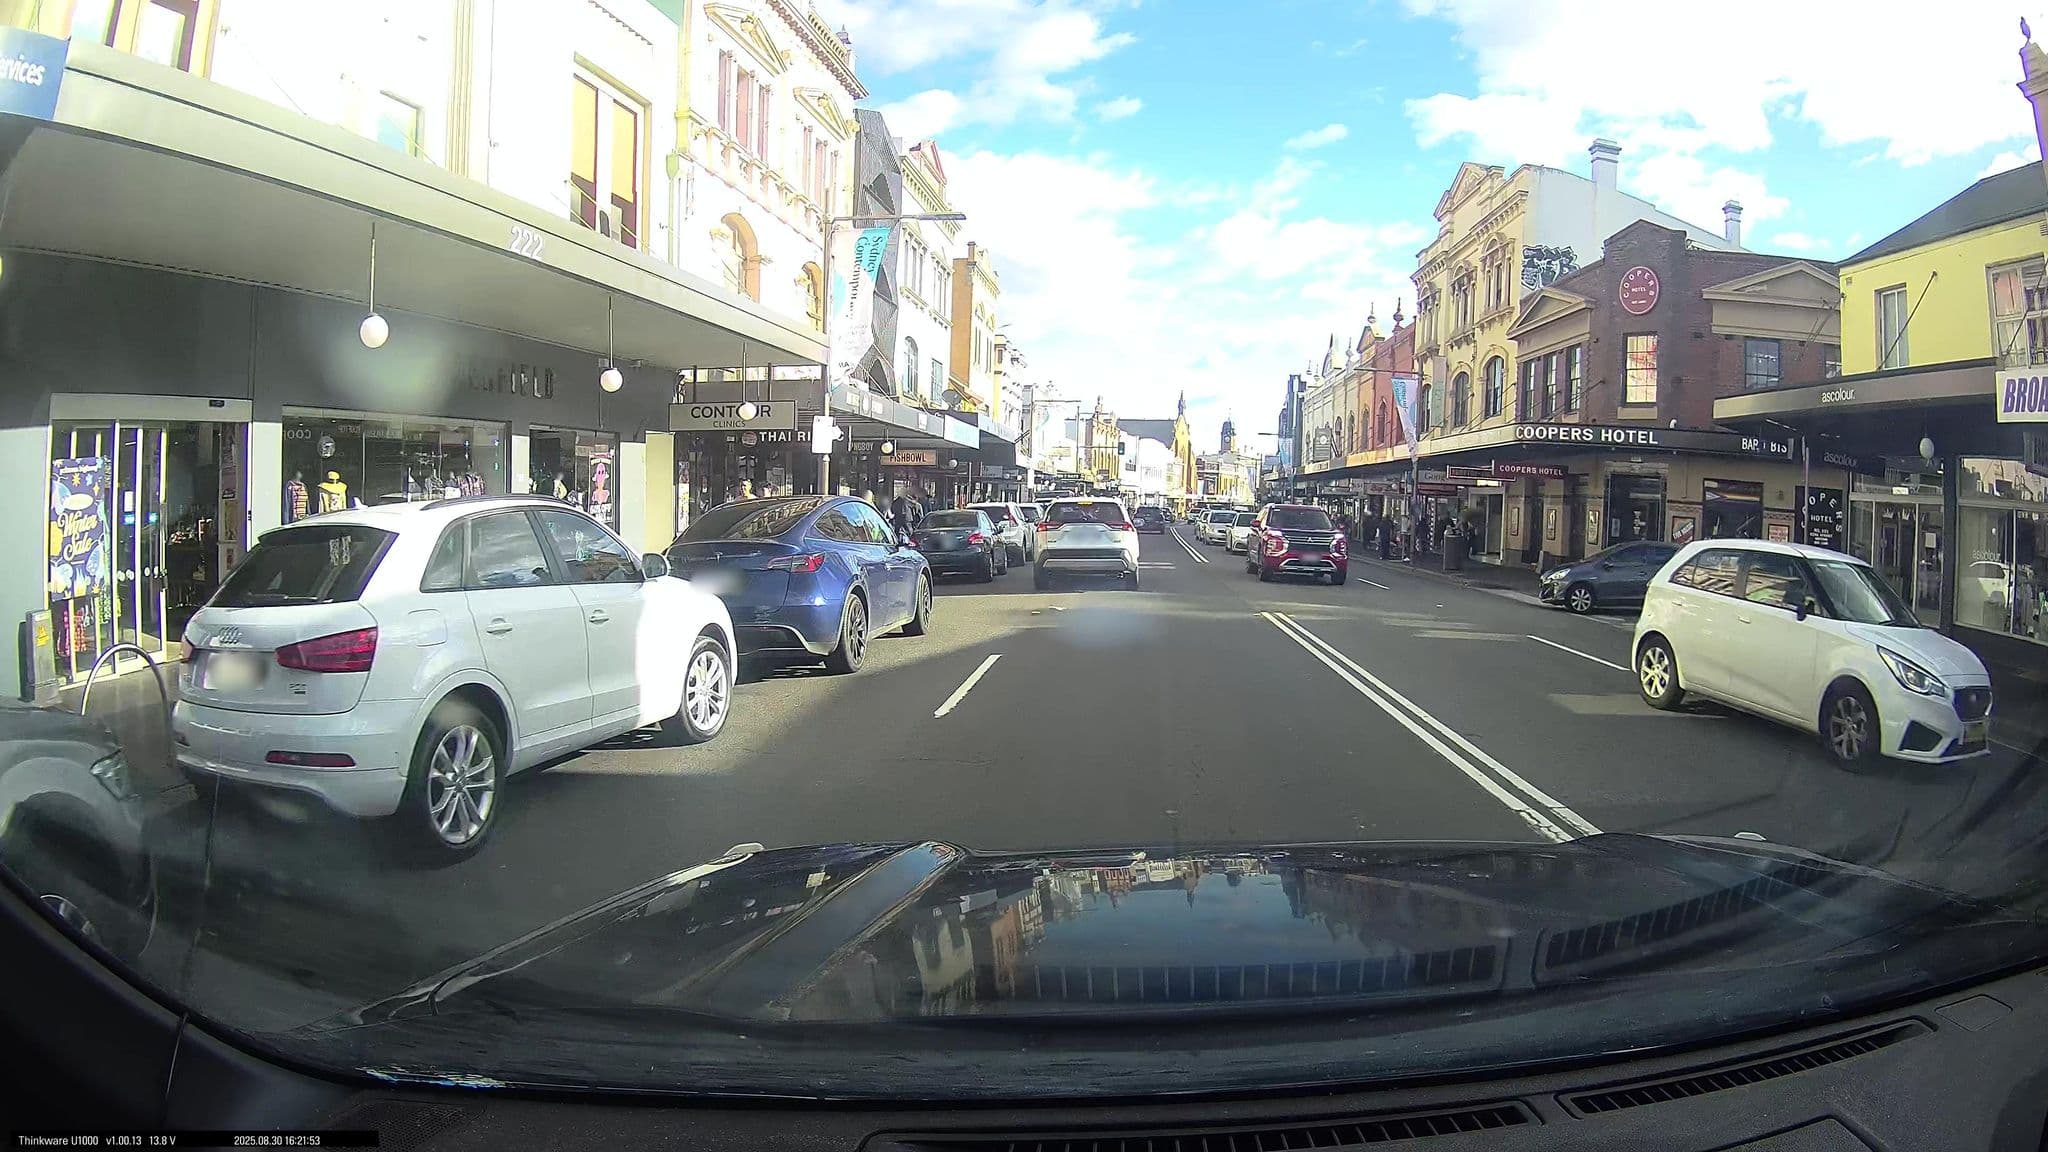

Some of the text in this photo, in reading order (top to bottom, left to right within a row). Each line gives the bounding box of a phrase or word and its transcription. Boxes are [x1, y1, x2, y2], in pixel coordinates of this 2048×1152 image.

[510, 226, 544, 260] 222
[867, 235, 883, 273] Sydney
[691, 404, 771, 419] CONTUR
[713, 420, 746, 428] CLINICS
[760, 431, 811, 441] THAI RI
[1515, 426, 1659, 445] COOPERS HOTEL
[1741, 438, 1760, 450] BAR
[889, 452, 927, 463] FISHBOWL
[1499, 465, 1537, 474] COOPERS
[1539, 468, 1563, 476] HOTEL
[57, 510, 98, 538] Winter
[1810, 514, 1833, 523] HOTEL
[63, 532, 93, 561] Sale
